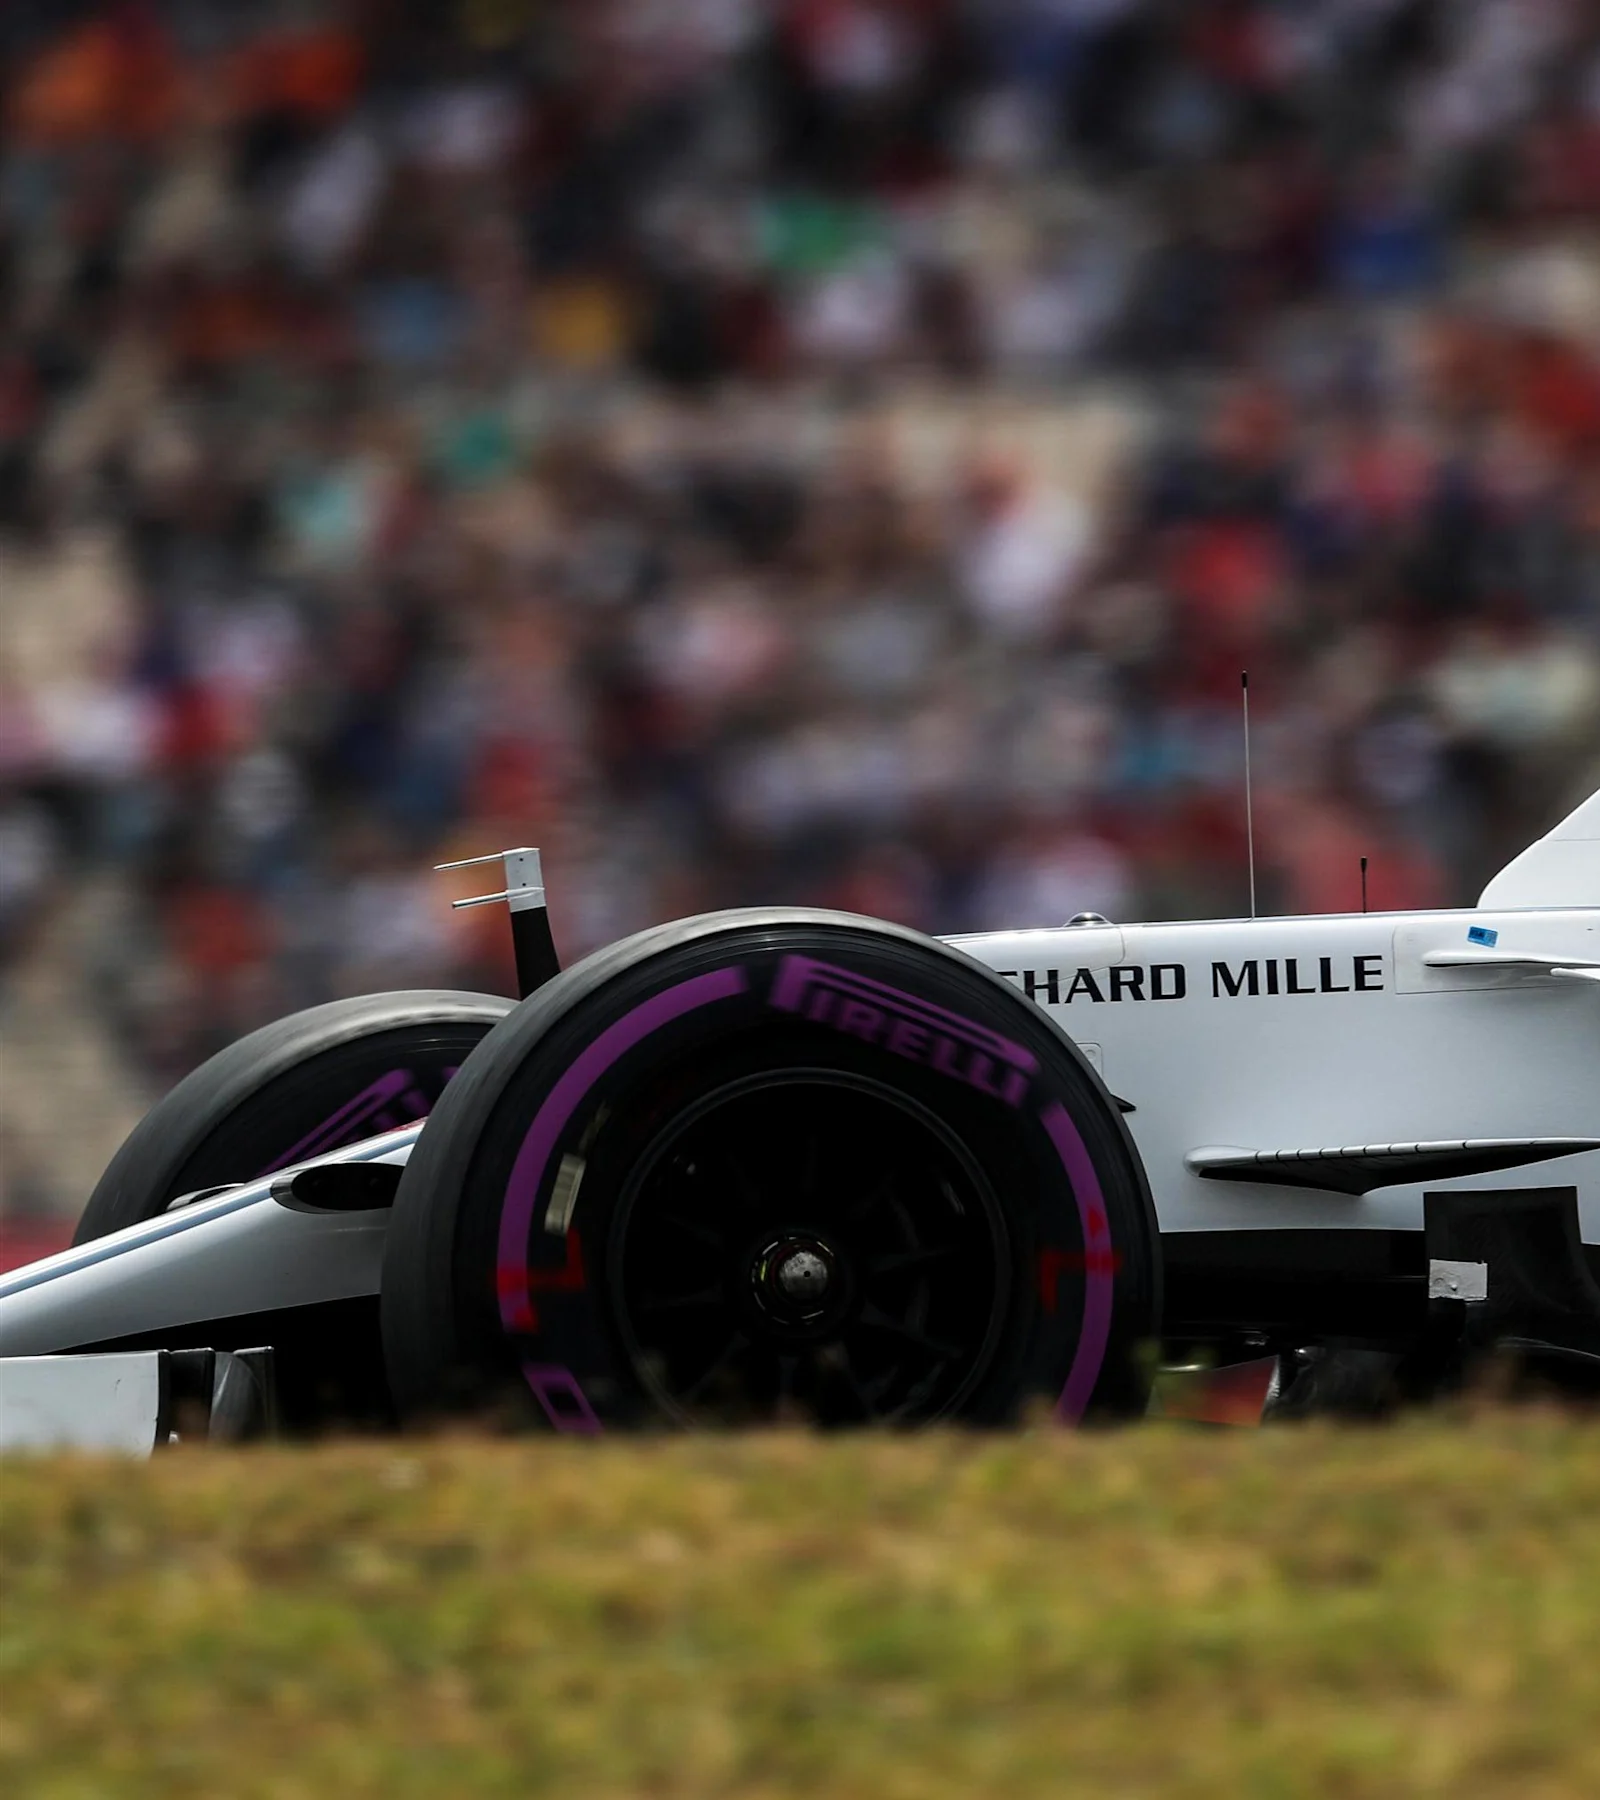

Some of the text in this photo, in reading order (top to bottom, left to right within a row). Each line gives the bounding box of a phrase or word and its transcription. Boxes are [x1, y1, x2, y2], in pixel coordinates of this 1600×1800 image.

[768, 953, 1040, 1107] PIRELLI
[997, 955, 1384, 1005] HARD MILLE
